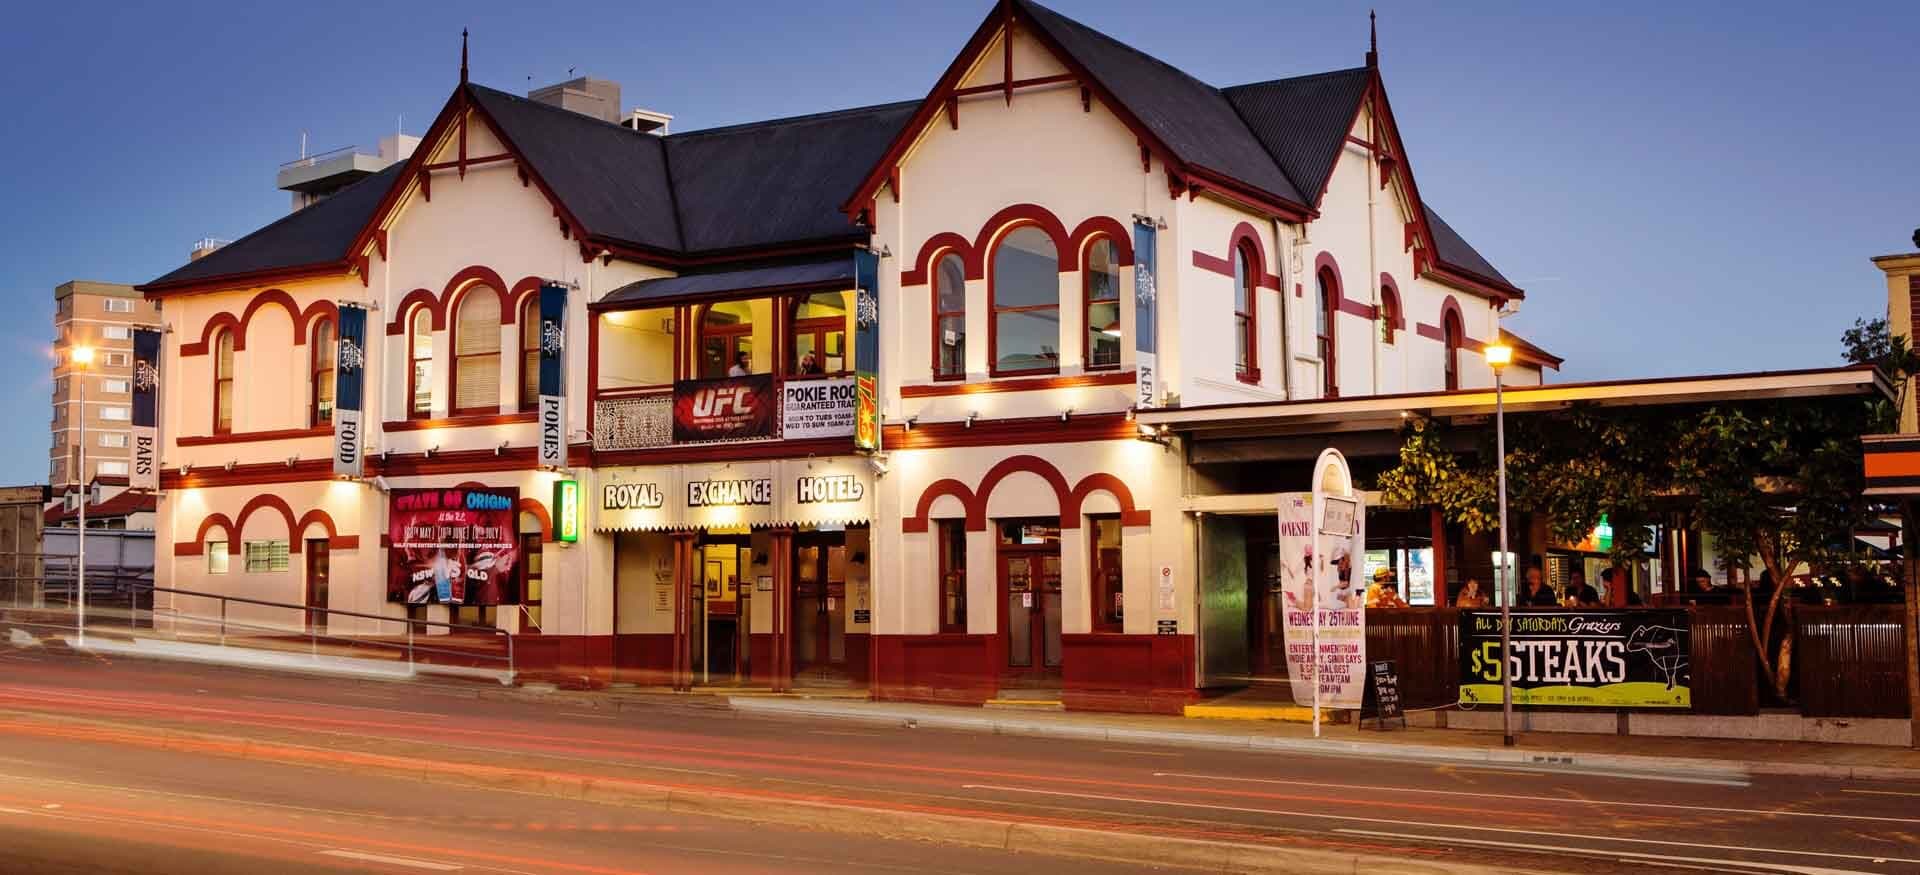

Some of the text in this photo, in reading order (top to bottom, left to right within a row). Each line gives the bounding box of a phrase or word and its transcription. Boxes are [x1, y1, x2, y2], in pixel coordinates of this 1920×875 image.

[543, 320, 552, 356] DRY
[341, 339, 351, 373] DRY
[136, 359, 146, 391] DRY
[786, 384, 855, 402] POKIE ROO
[1141, 366, 1153, 408] KEN
[692, 386, 754, 418] UFC
[543, 399, 560, 461] POKIES
[803, 422, 811, 430] TO
[340, 420, 356, 464] FOOD
[136, 436, 153, 475] BARS
[466, 492, 512, 510] ORIGIN
[604, 475, 864, 510] ROYAL EXCHANGE HOTEL
[1281, 522, 1311, 536] ONESIE
[413, 568, 434, 582] NSW
[467, 568, 488, 580] QLD
[1289, 611, 1326, 626] WEDNESAY
[1475, 616, 1622, 634] ALL DY SATURDAYS Graziers
[1290, 644, 1341, 653] ENTERTNMENT
[1345, 655, 1362, 664] SAYS
[1471, 640, 1625, 683] $5 STEAKS
[1306, 664, 1333, 674] SPCIAL
